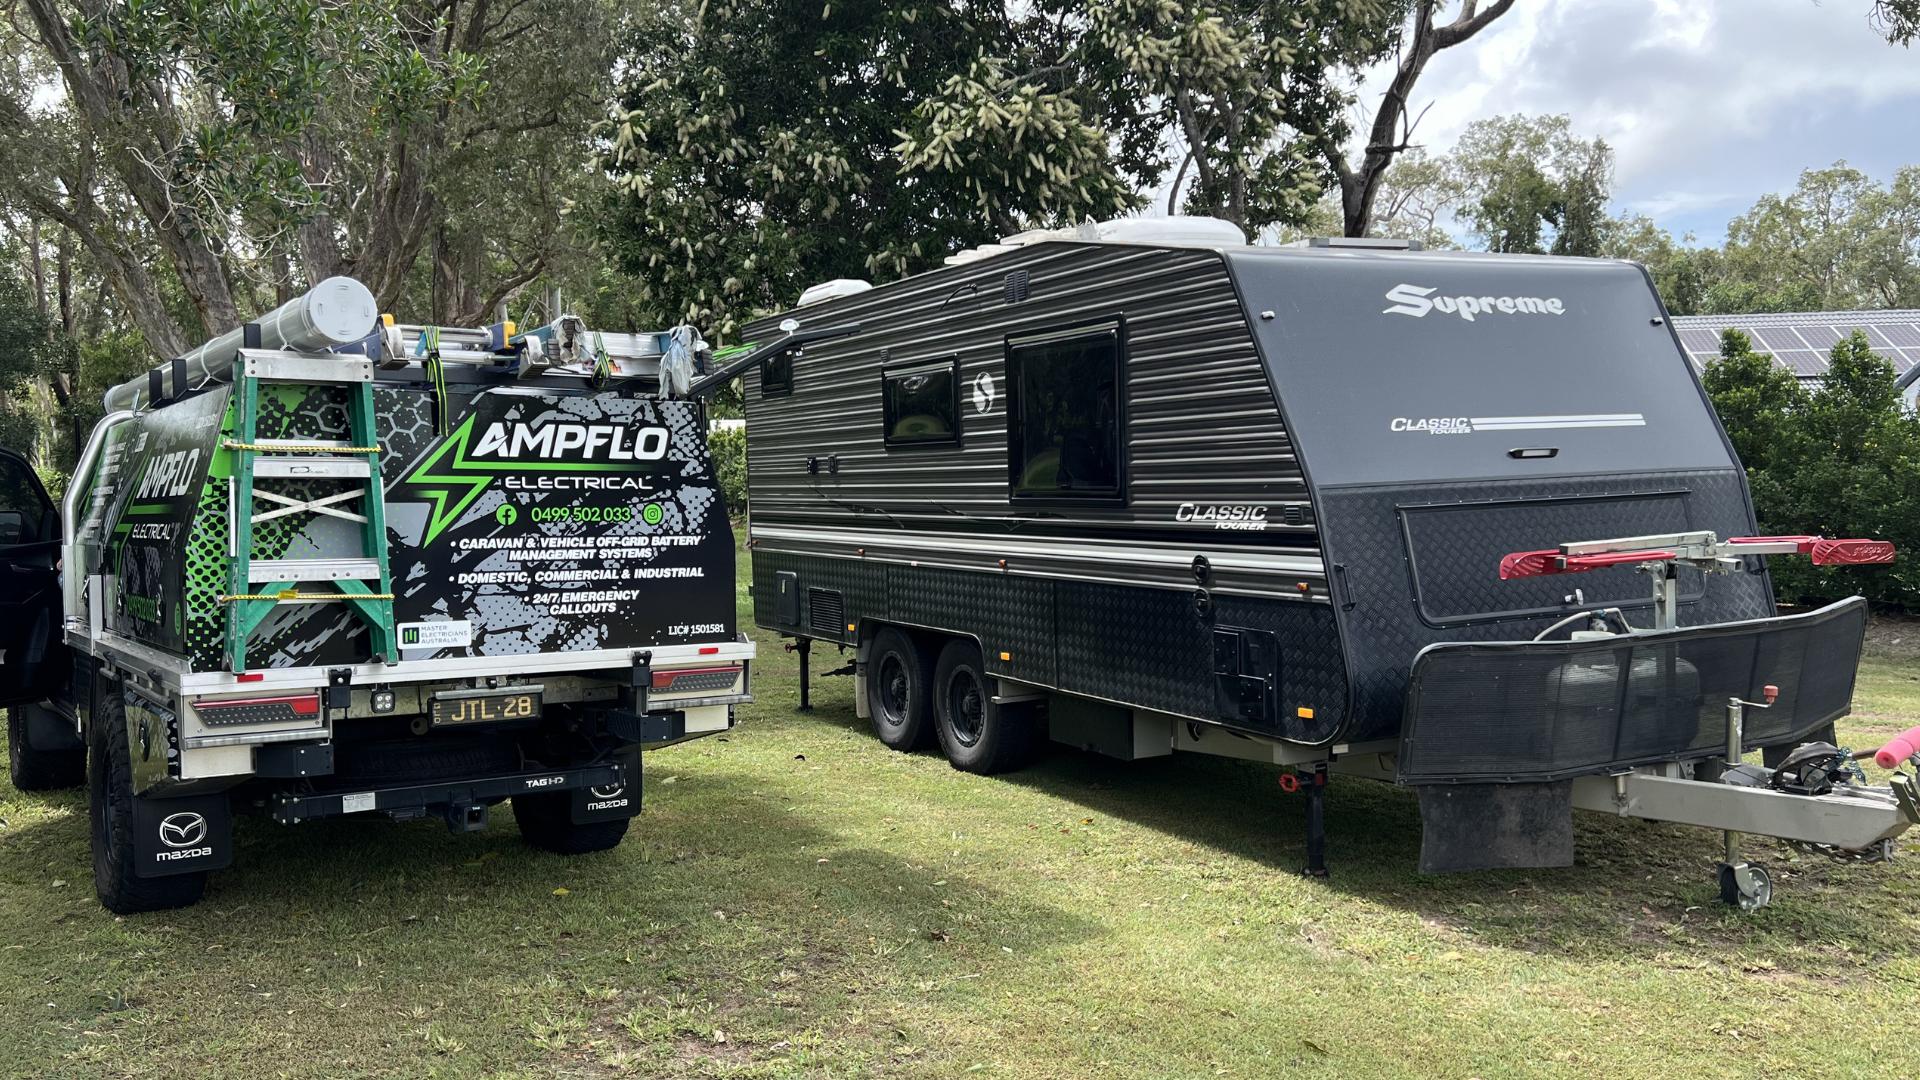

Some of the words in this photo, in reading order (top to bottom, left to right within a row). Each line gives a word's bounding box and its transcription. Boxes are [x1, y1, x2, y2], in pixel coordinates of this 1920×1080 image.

[1382, 283, 1566, 322] Supreme
[1390, 417, 1468, 432] CLASSIC
[471, 422, 669, 460] AMPFLO
[136, 448, 200, 499] AMPFLO
[505, 476, 653, 490] ELECTRICAL
[531, 507, 569, 521] 0499
[573, 507, 600, 521] 502
[603, 507, 631, 521] 033
[1175, 502, 1268, 522] CLASSIC
[132, 522, 172, 540] ELECTRICAL
[1214, 522, 1268, 531] TOURER
[459, 538, 524, 549] CARAVAN
[526, 537, 536, 548] &
[540, 537, 595, 548] VEHICLE
[596, 536, 649, 547] OFF-GRID
[651, 536, 702, 546] BATTERY
[509, 549, 597, 561] MANAGEMENT
[598, 548, 652, 559] SYSTEMS
[458, 571, 531, 584] DOMESTIC,
[535, 569, 620, 582] COMMERCIAL
[621, 569, 631, 579] &
[634, 567, 704, 579] INDUSTRIAL
[532, 593, 559, 604] 24/7
[561, 590, 640, 603] EMERGENCY
[549, 603, 617, 615] CALLOUTS
[421, 630, 468, 638] ELECTRICIANS
[668, 625, 689, 635] LIC#
[690, 623, 725, 634] 1501581
[525, 778, 547, 788] TAG
[587, 798, 628, 811] mazda
[156, 846, 212, 862] mazda
